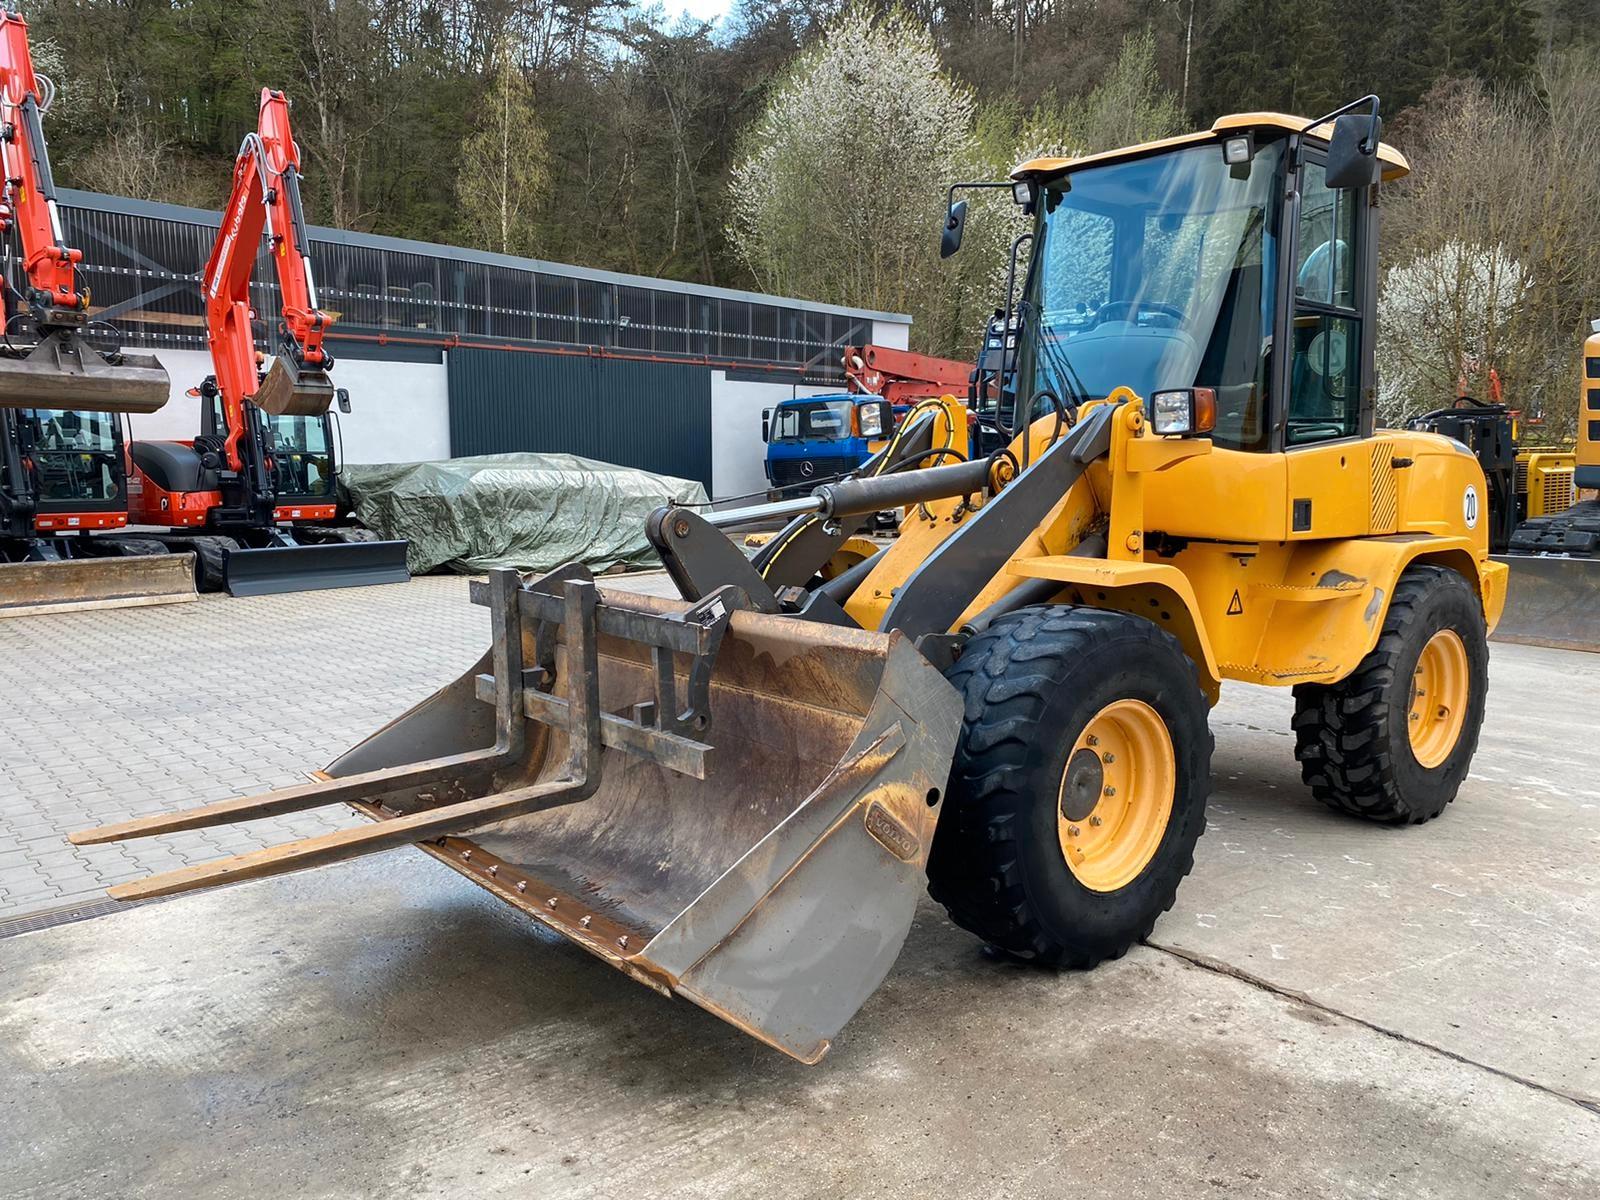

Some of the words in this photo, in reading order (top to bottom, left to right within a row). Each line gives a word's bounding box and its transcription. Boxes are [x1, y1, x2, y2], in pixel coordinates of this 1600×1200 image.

[229, 195, 247, 240] Kubota
[1465, 493, 1476, 521] 20
[876, 818, 910, 851] VOLVO
